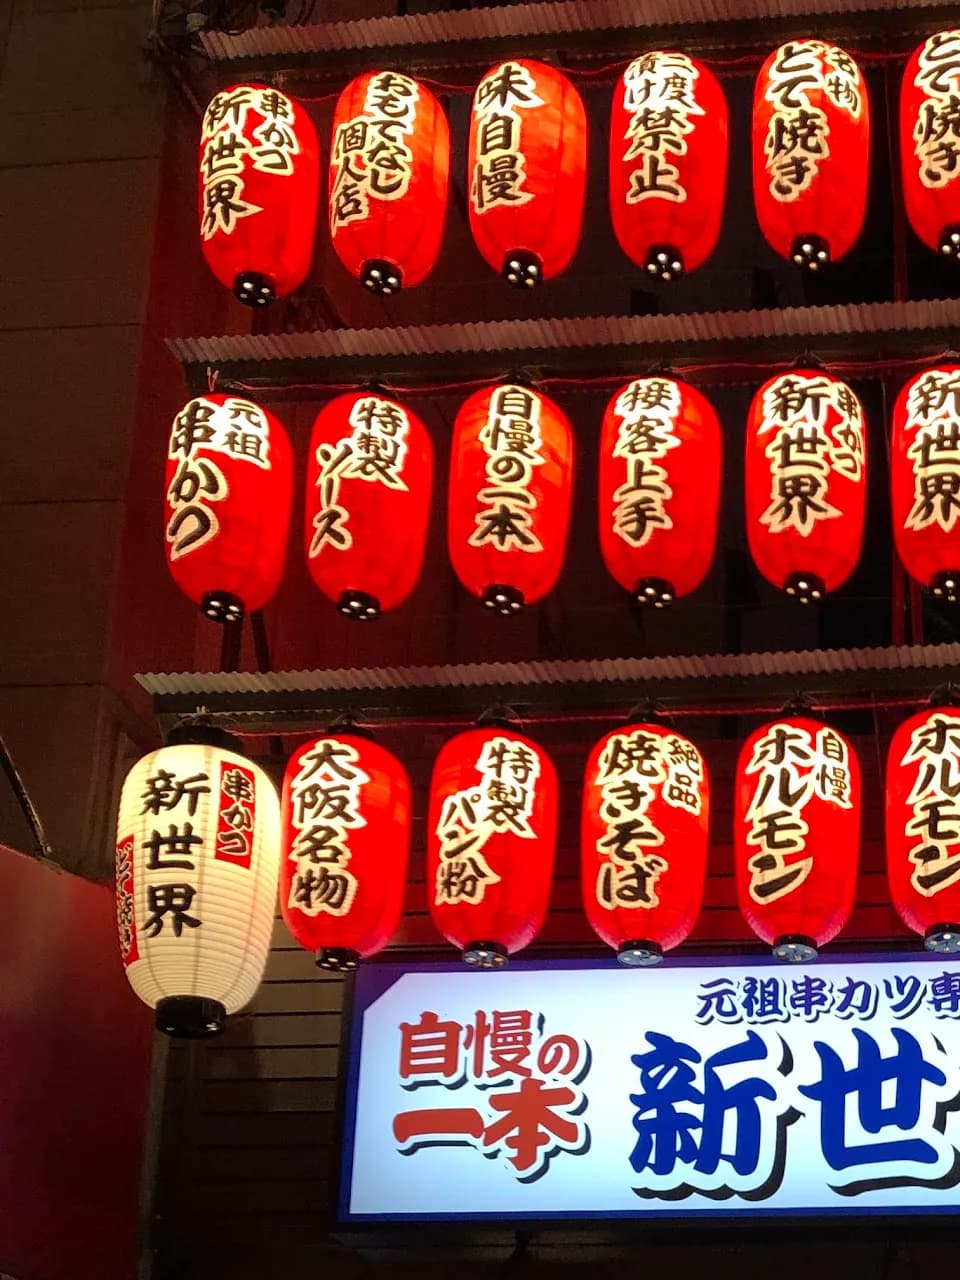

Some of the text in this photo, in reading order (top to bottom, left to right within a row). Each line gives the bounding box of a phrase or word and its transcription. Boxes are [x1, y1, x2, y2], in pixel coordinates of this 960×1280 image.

[256, 91, 295, 171] 串かつ
[367, 72, 413, 195] おもてなし
[658, 55, 694, 107] 二度
[202, 89, 252, 234] 新世界
[334, 119, 369, 227] 個人店
[476, 65, 533, 209] 味自慢
[628, 108, 686, 198] 禁止
[168, 400, 220, 551] 串かつ
[223, 400, 266, 465] 元祖
[352, 400, 404, 484] 特製
[477, 387, 537, 547] 自慢の一本
[617, 382, 671, 542] 接客上手
[769, 378, 834, 525] 新世界
[832, 383, 863, 476] 串かつ
[311, 444, 353, 550] ソース
[219, 768, 254, 858] 串かつ
[484, 741, 535, 834] 特製
[602, 734, 667, 905] 焼きそば
[665, 738, 700, 811] 絶品
[749, 728, 813, 898] ホルモン
[816, 730, 851, 804] 自慢
[139, 768, 211, 938] 新世界
[296, 741, 357, 910] 大阪名物
[440, 793, 487, 900] パン粉
[398, 1008, 582, 1082] 自慢の
[392, 1077, 580, 1173] 一本
